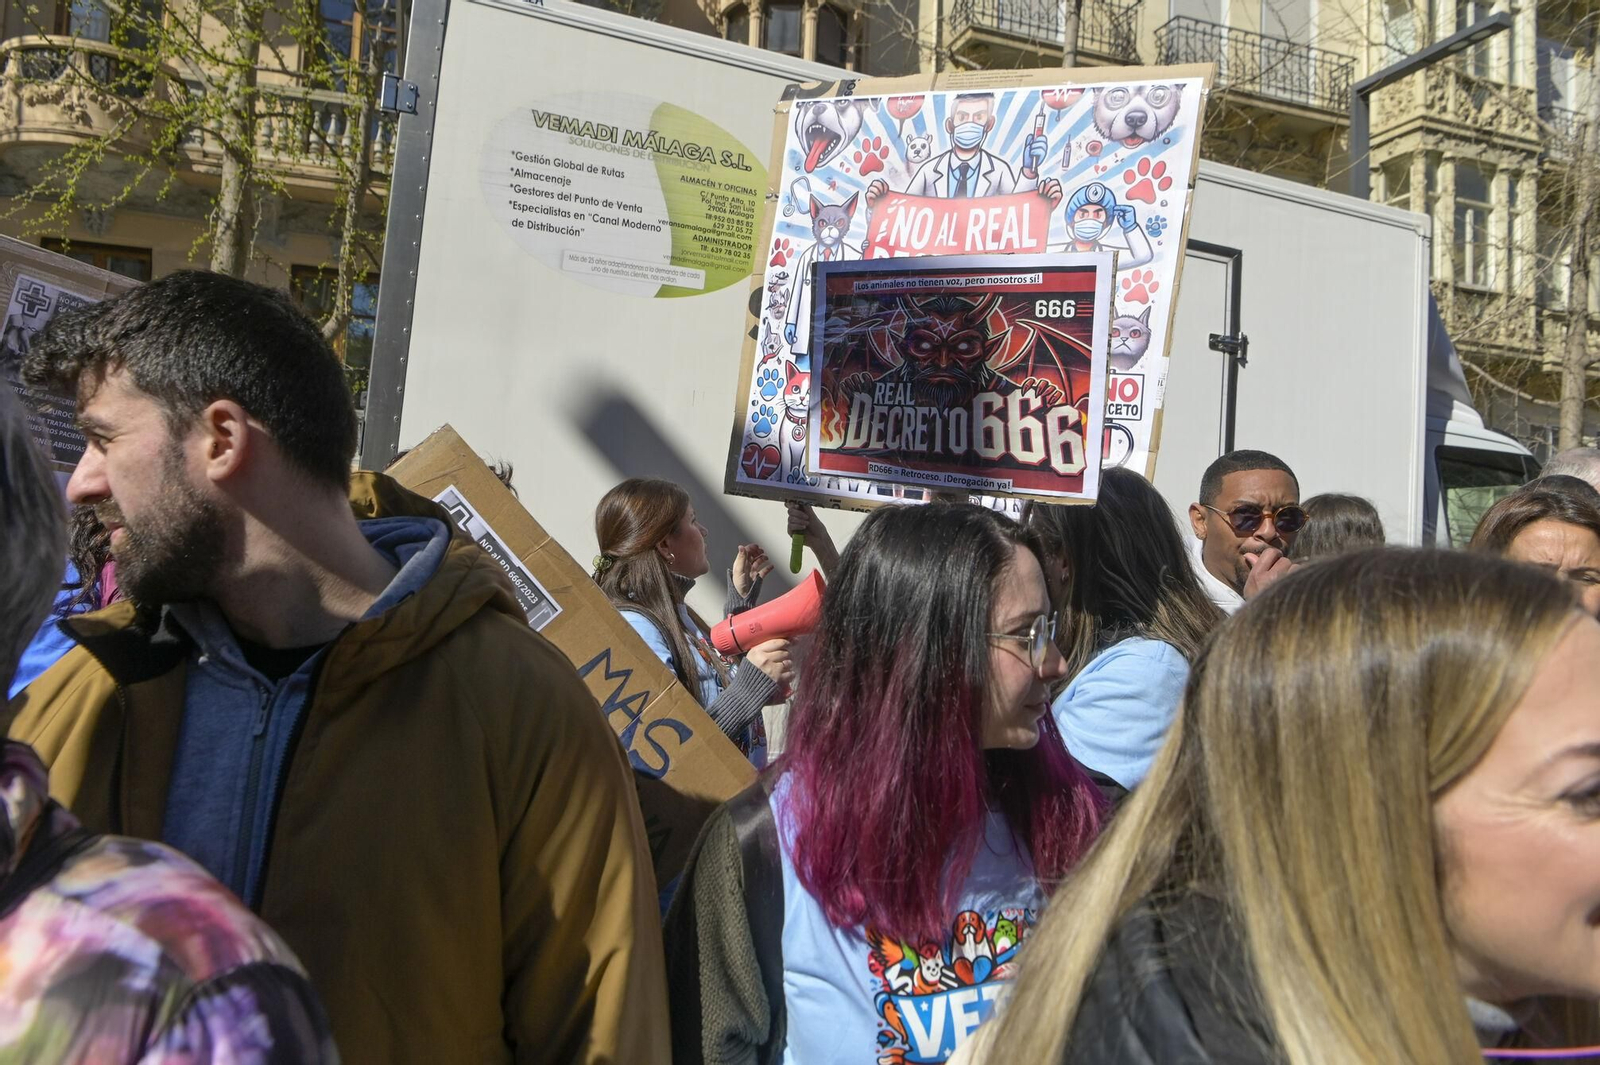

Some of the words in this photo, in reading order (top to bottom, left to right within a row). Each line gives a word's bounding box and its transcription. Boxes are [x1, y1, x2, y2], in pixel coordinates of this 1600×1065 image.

[532, 109, 618, 143] VEMADI
[622, 130, 716, 164] MÁLAGA
[720, 150, 752, 172] S.L.
[568, 136, 631, 156] SOLUCIONES
[632, 149, 646, 159] DE
[554, 158, 584, 172] Global
[586, 164, 599, 174] de
[602, 166, 625, 179] Rutas
[680, 175, 715, 188] ALMACÉN
[724, 184, 757, 197] OFICINAS
[557, 191, 572, 201] del
[574, 194, 600, 206] Punto
[602, 199, 614, 209] de
[617, 201, 643, 213] Venta
[710, 193, 729, 202] Punta
[511, 219, 524, 228] de
[622, 219, 662, 232] Moderno
[745, 227, 753, 235] 72
[935, 212, 958, 247] AL
[965, 203, 1038, 251] REAL
[692, 234, 753, 251] ADMINISTRADOR
[710, 246, 723, 254] 639
[742, 252, 751, 260] 35
[569, 254, 580, 262] Más
[686, 271, 700, 279] cada
[870, 279, 905, 289] animales
[906, 280, 916, 288] no
[918, 278, 944, 287] tienen
[946, 278, 963, 287] voz,
[965, 277, 985, 287] pero
[987, 276, 1027, 284] nosotros
[1029, 274, 1040, 283] sí!
[1035, 300, 1076, 318] 666
[873, 382, 915, 405] REAL
[50, 409, 75, 419] UROC
[28, 424, 58, 435] UESTROS
[846, 391, 968, 455] DECRETO
[973, 391, 1087, 476] 666
[53, 441, 85, 453] ABUSIVAS
[868, 463, 893, 475] RD666
[901, 468, 942, 482] Retroceso.
[943, 475, 995, 488] ¡Derogación
[996, 481, 1011, 491] ya!
[479, 538, 493, 553] NO
[491, 550, 501, 561] al
[508, 571, 539, 604] 666/2023
[576, 647, 693, 780] MAS
